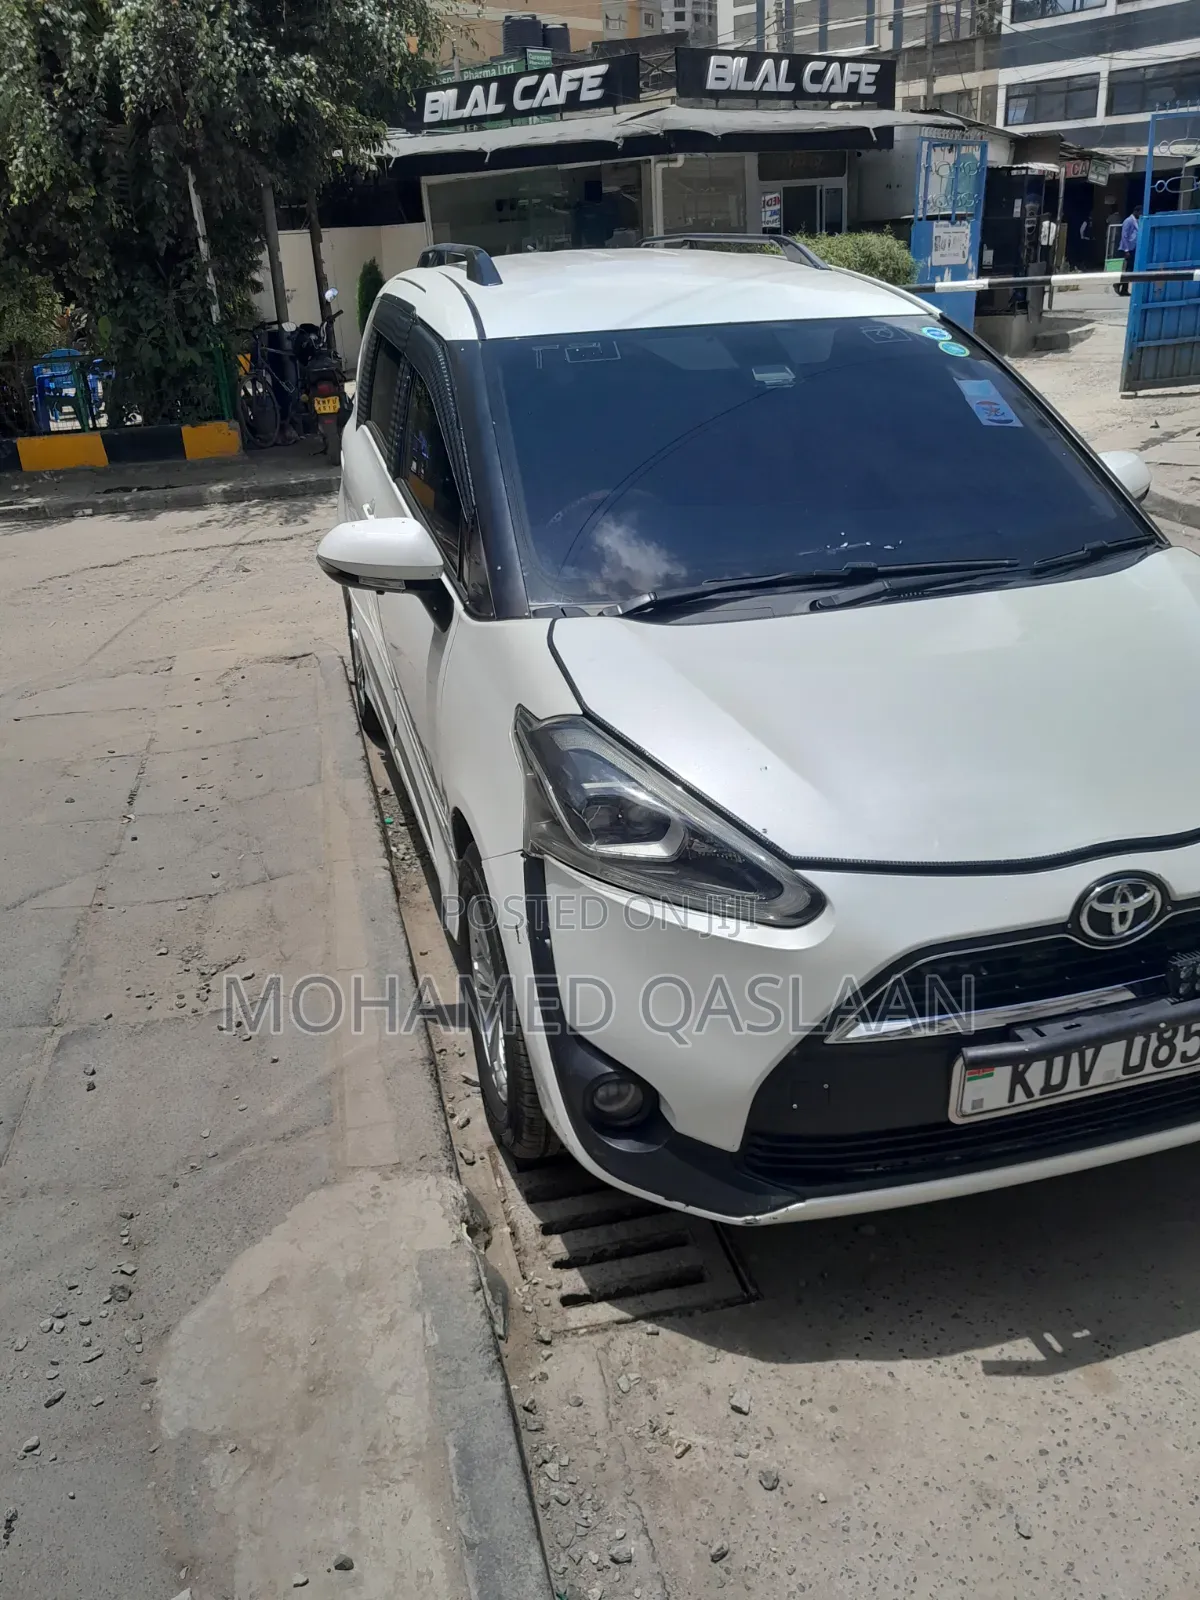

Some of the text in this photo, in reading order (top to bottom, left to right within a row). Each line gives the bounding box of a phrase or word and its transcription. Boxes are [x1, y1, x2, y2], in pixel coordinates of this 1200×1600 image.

[424, 64, 609, 123] BILAL CAFE
[463, 67, 496, 81] Pharma
[707, 55, 882, 94] BILAL CAFE
[1007, 1022, 1200, 1104] KDV 085
